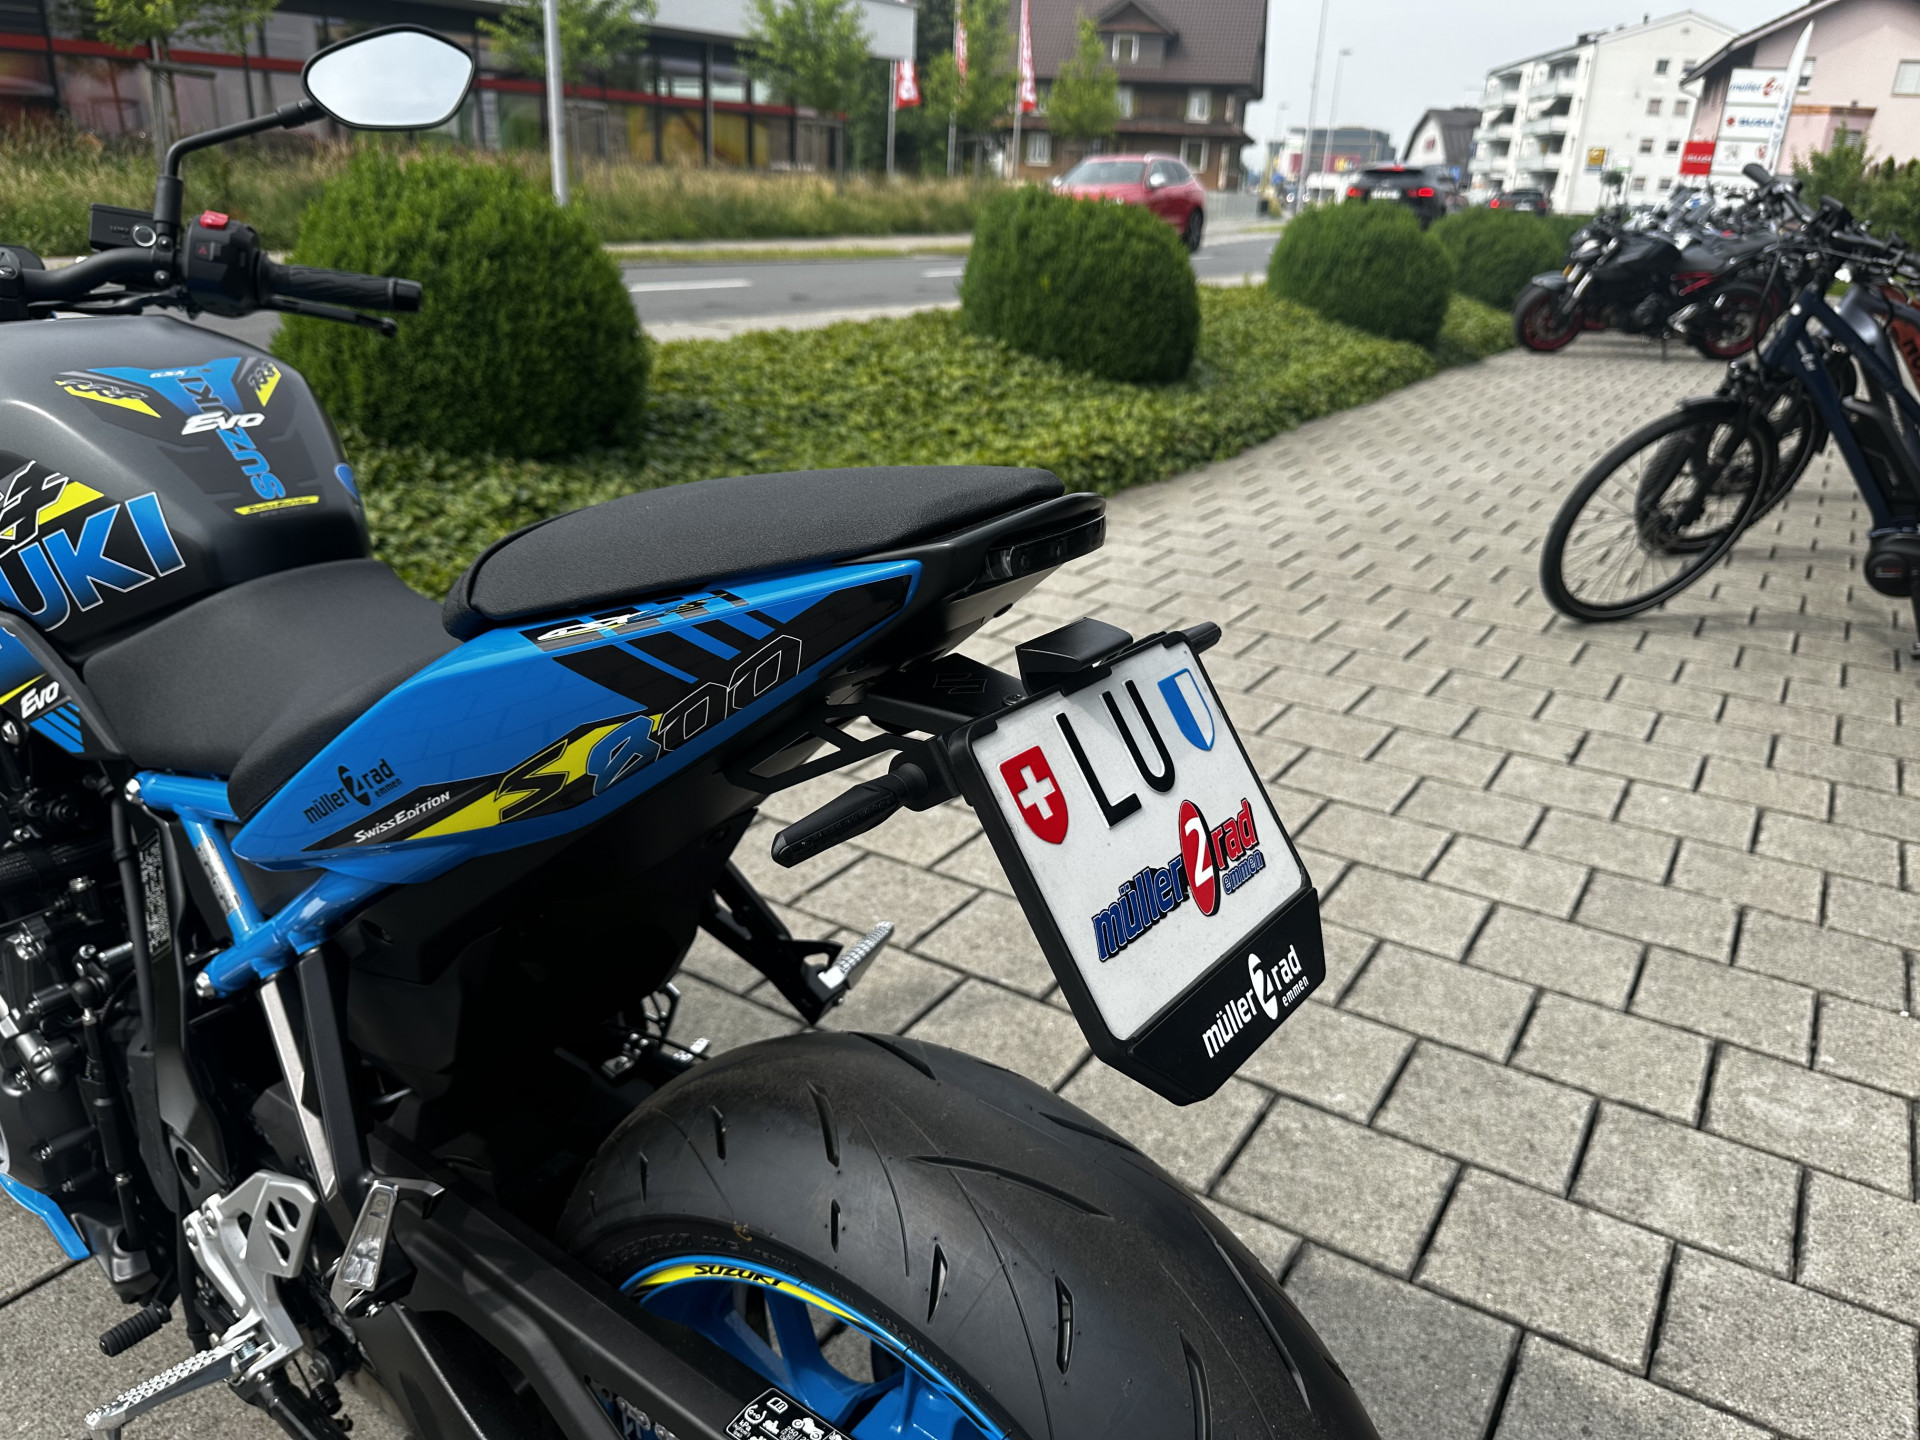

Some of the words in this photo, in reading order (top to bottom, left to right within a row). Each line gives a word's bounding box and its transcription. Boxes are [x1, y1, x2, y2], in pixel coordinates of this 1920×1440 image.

[1056, 679, 1176, 829] LU
[375, 777, 403, 798] emmen
[1222, 848, 1265, 895] emmen
[1281, 975, 1310, 1007] emmen
[693, 1264, 783, 1288] SUZUKI
